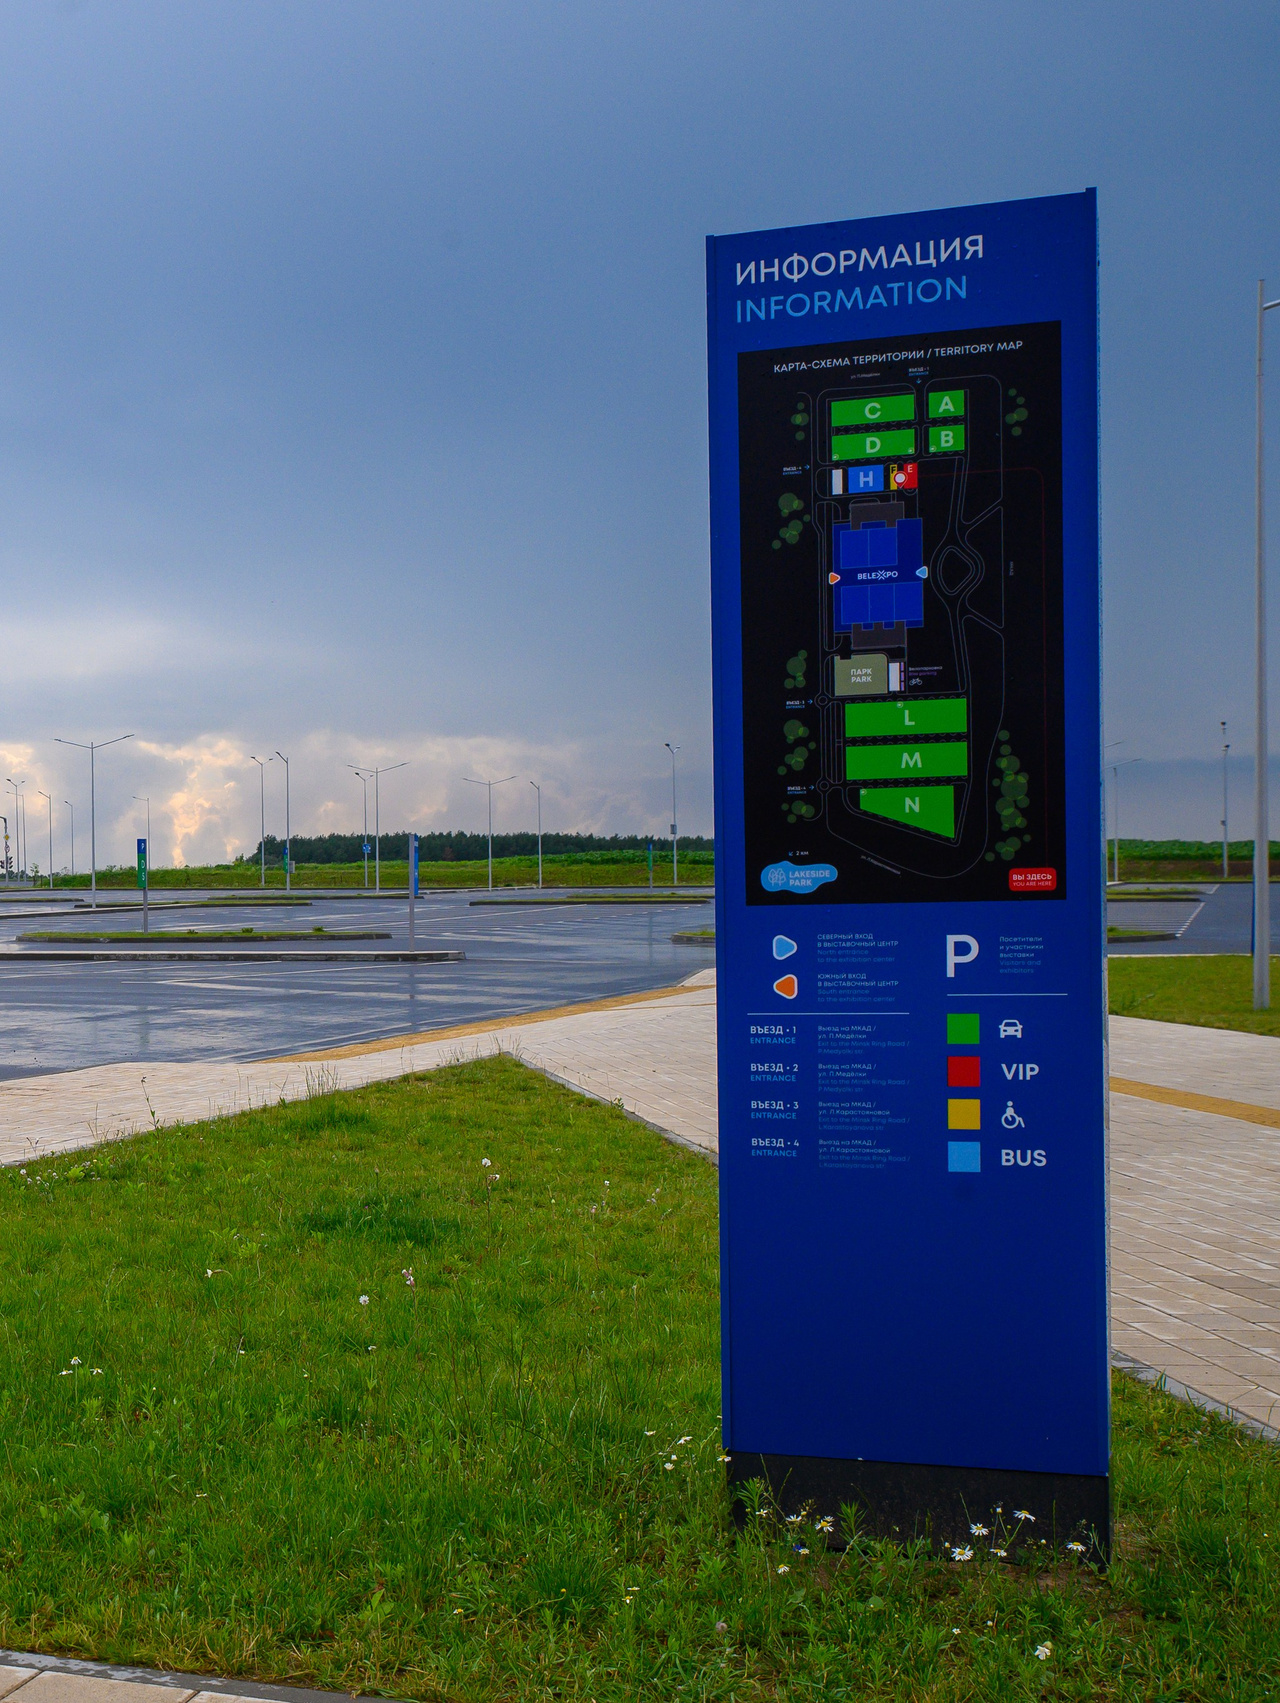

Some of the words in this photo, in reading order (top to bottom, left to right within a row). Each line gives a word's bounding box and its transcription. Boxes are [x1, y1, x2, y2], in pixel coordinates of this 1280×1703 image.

[736, 234, 984, 286] ИНФОРМАЦИЯ
[737, 275, 967, 323] INFORMATION
[773, 357, 850, 373] КАРТА-СХЕМА
[852, 349, 924, 365] ТЕРРИТОРИИ
[933, 342, 995, 358] TERRITORY
[996, 340, 1023, 351] MAP
[864, 402, 882, 419] C
[938, 396, 955, 413] A
[865, 437, 881, 453] D
[940, 430, 954, 447] B
[907, 464, 913, 473] E
[859, 471, 874, 488] H
[857, 570, 899, 580] BELEXPO
[904, 710, 916, 726] L
[900, 752, 922, 768] M
[904, 797, 920, 813] N
[789, 870, 830, 878] LAKESIDE
[946, 934, 980, 978] P
[750, 1025, 783, 1035] ВЪЕЗД
[750, 1063, 784, 1072] ВЪЕЗД
[793, 1064, 798, 1072] 2
[1001, 1063, 1040, 1080] VIP
[751, 1101, 784, 1110] ВЪЕЗД
[793, 1101, 799, 1110] 3
[751, 1138, 784, 1148] ВЪЕЗД
[1001, 1149, 1047, 1167] BUS
